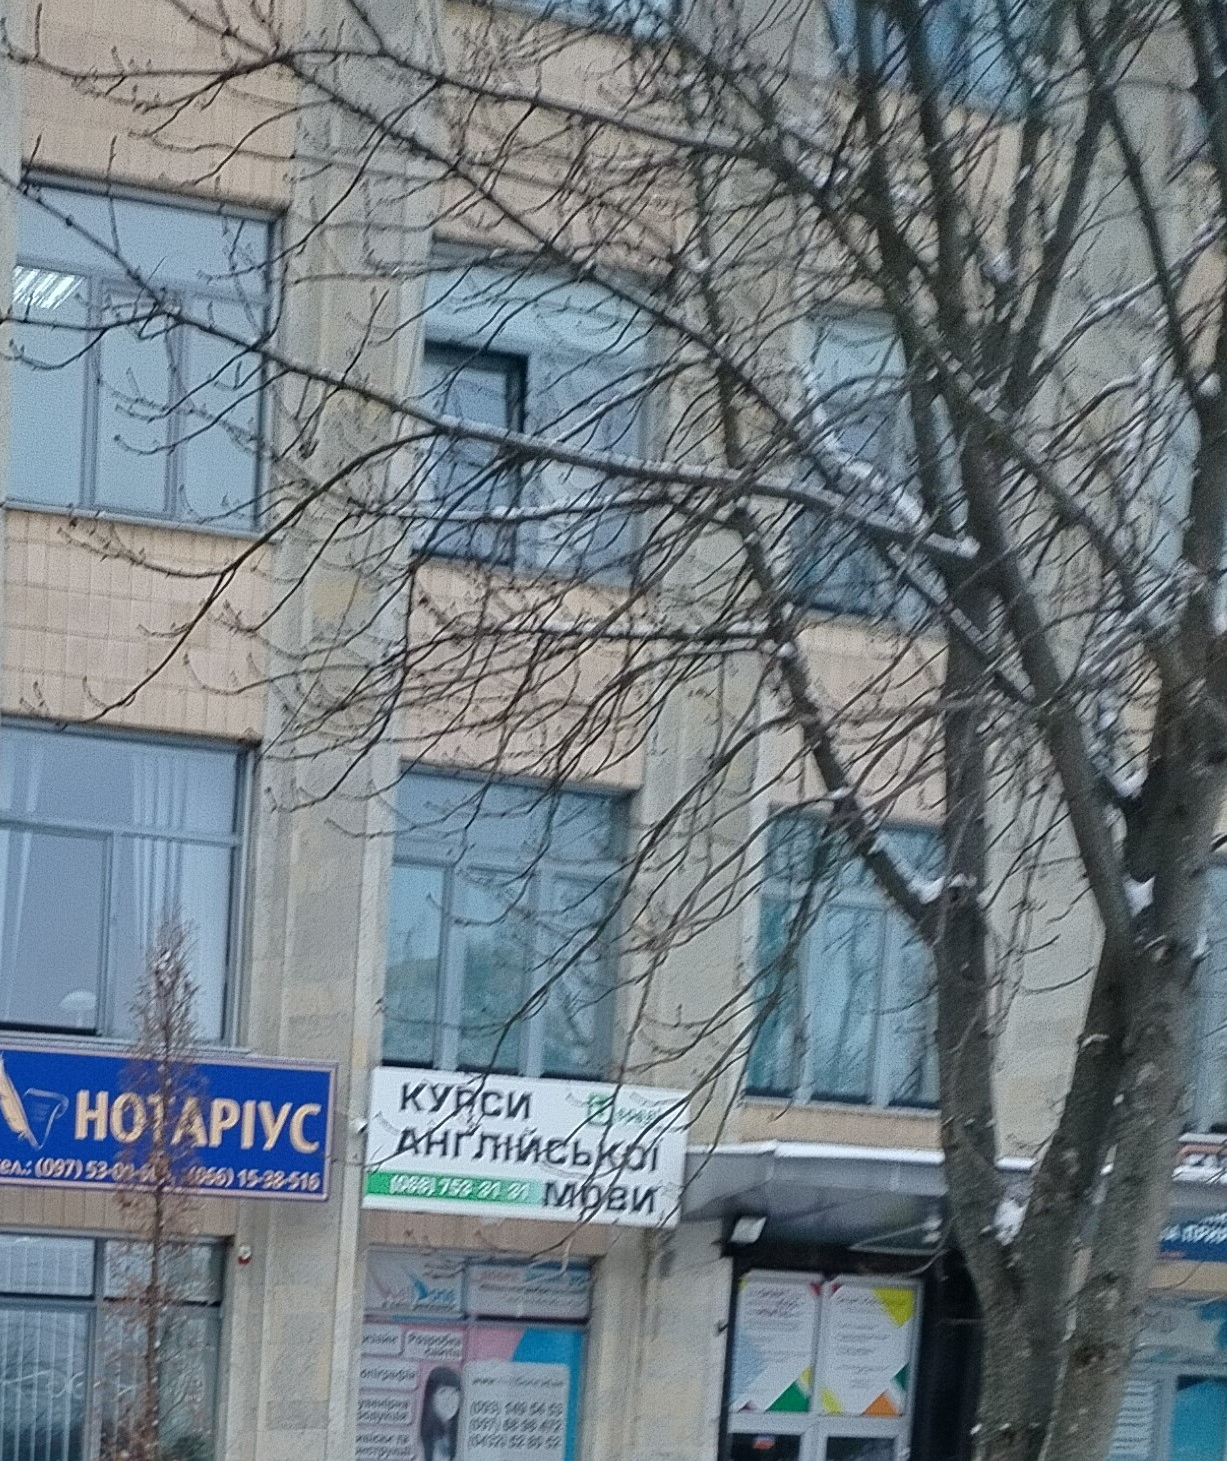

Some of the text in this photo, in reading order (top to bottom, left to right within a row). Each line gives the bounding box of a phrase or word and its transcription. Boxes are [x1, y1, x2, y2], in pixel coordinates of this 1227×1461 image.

[400, 1082, 532, 1119] КУРСИ
[74, 1089, 322, 1153] НОТАРІУС
[543, 1181, 659, 1214] МОВИ
